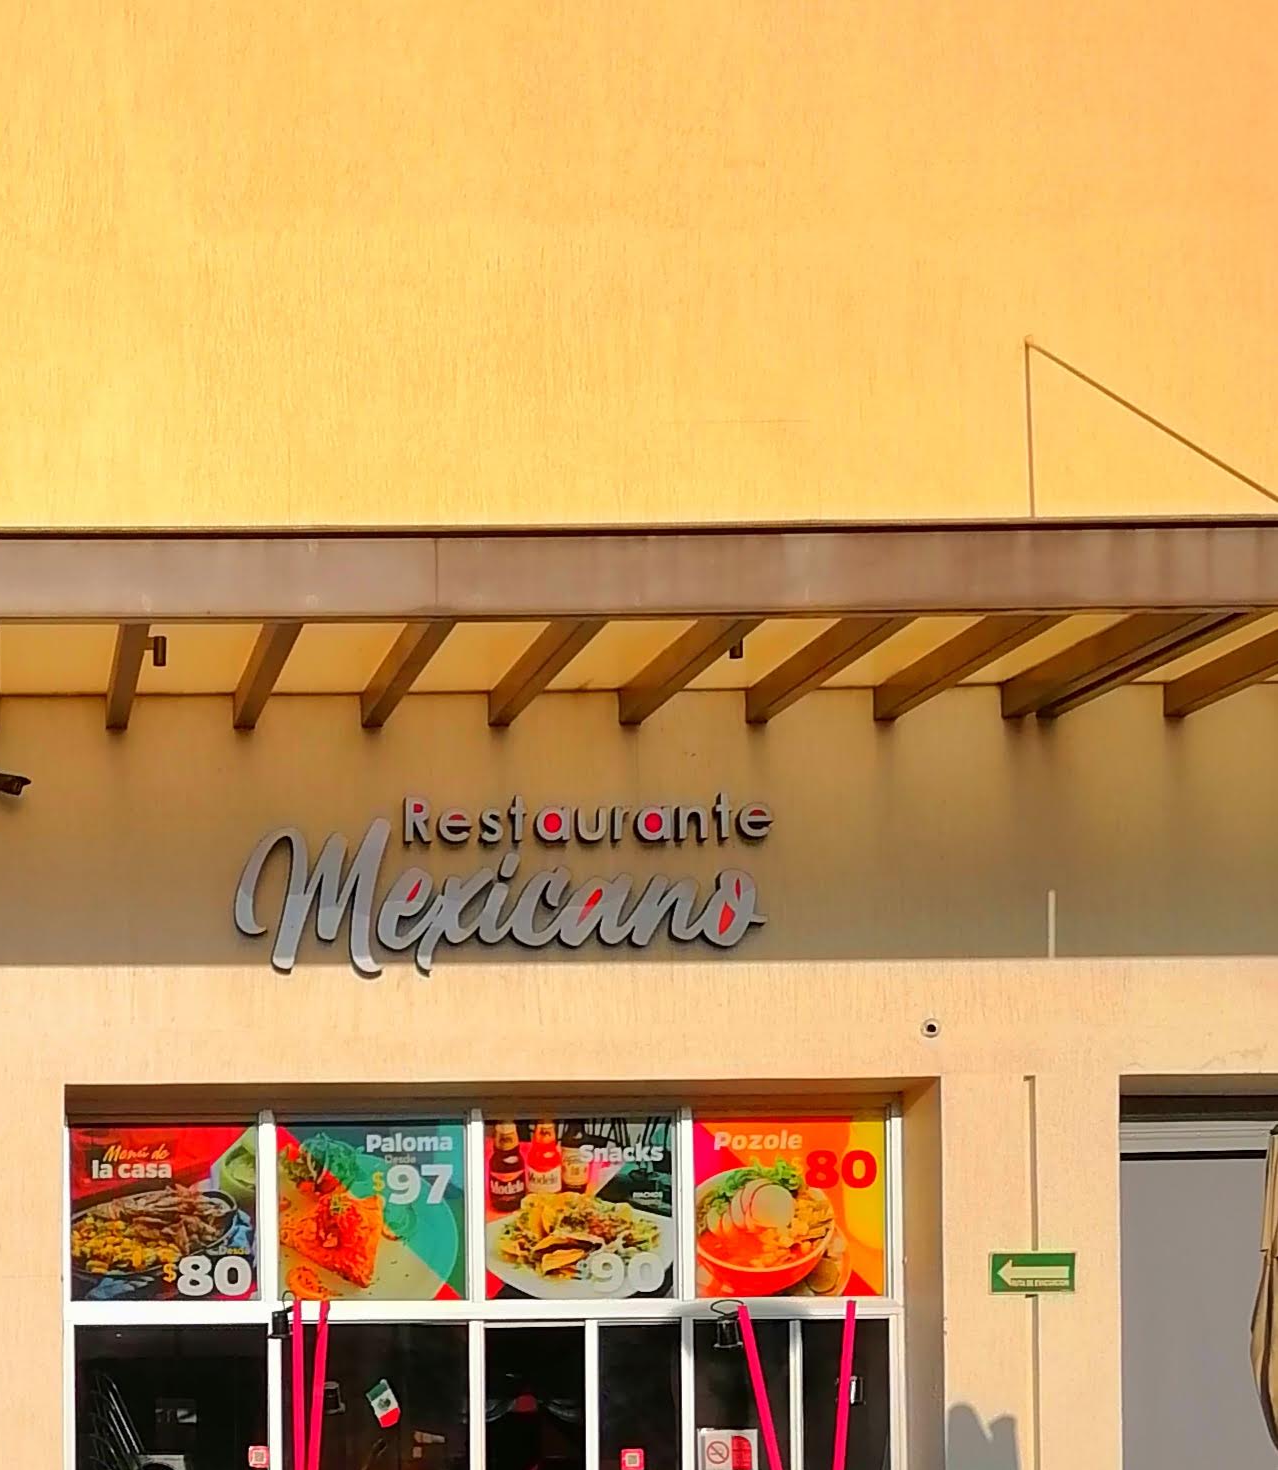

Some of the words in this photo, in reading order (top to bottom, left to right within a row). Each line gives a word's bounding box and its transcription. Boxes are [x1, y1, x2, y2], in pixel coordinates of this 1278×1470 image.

[404, 793, 773, 843] Restaurante
[234, 818, 769, 975] Mexicano
[366, 1132, 454, 1153] Paloma
[713, 1130, 803, 1151] Pozole
[102, 1143, 149, 1161] Menú
[151, 1142, 171, 1161] de
[578, 1142, 664, 1163] Snacks
[91, 1158, 114, 1179] la
[117, 1161, 172, 1179] casa
[372, 1164, 454, 1205] $97
[162, 1254, 253, 1297] $80
